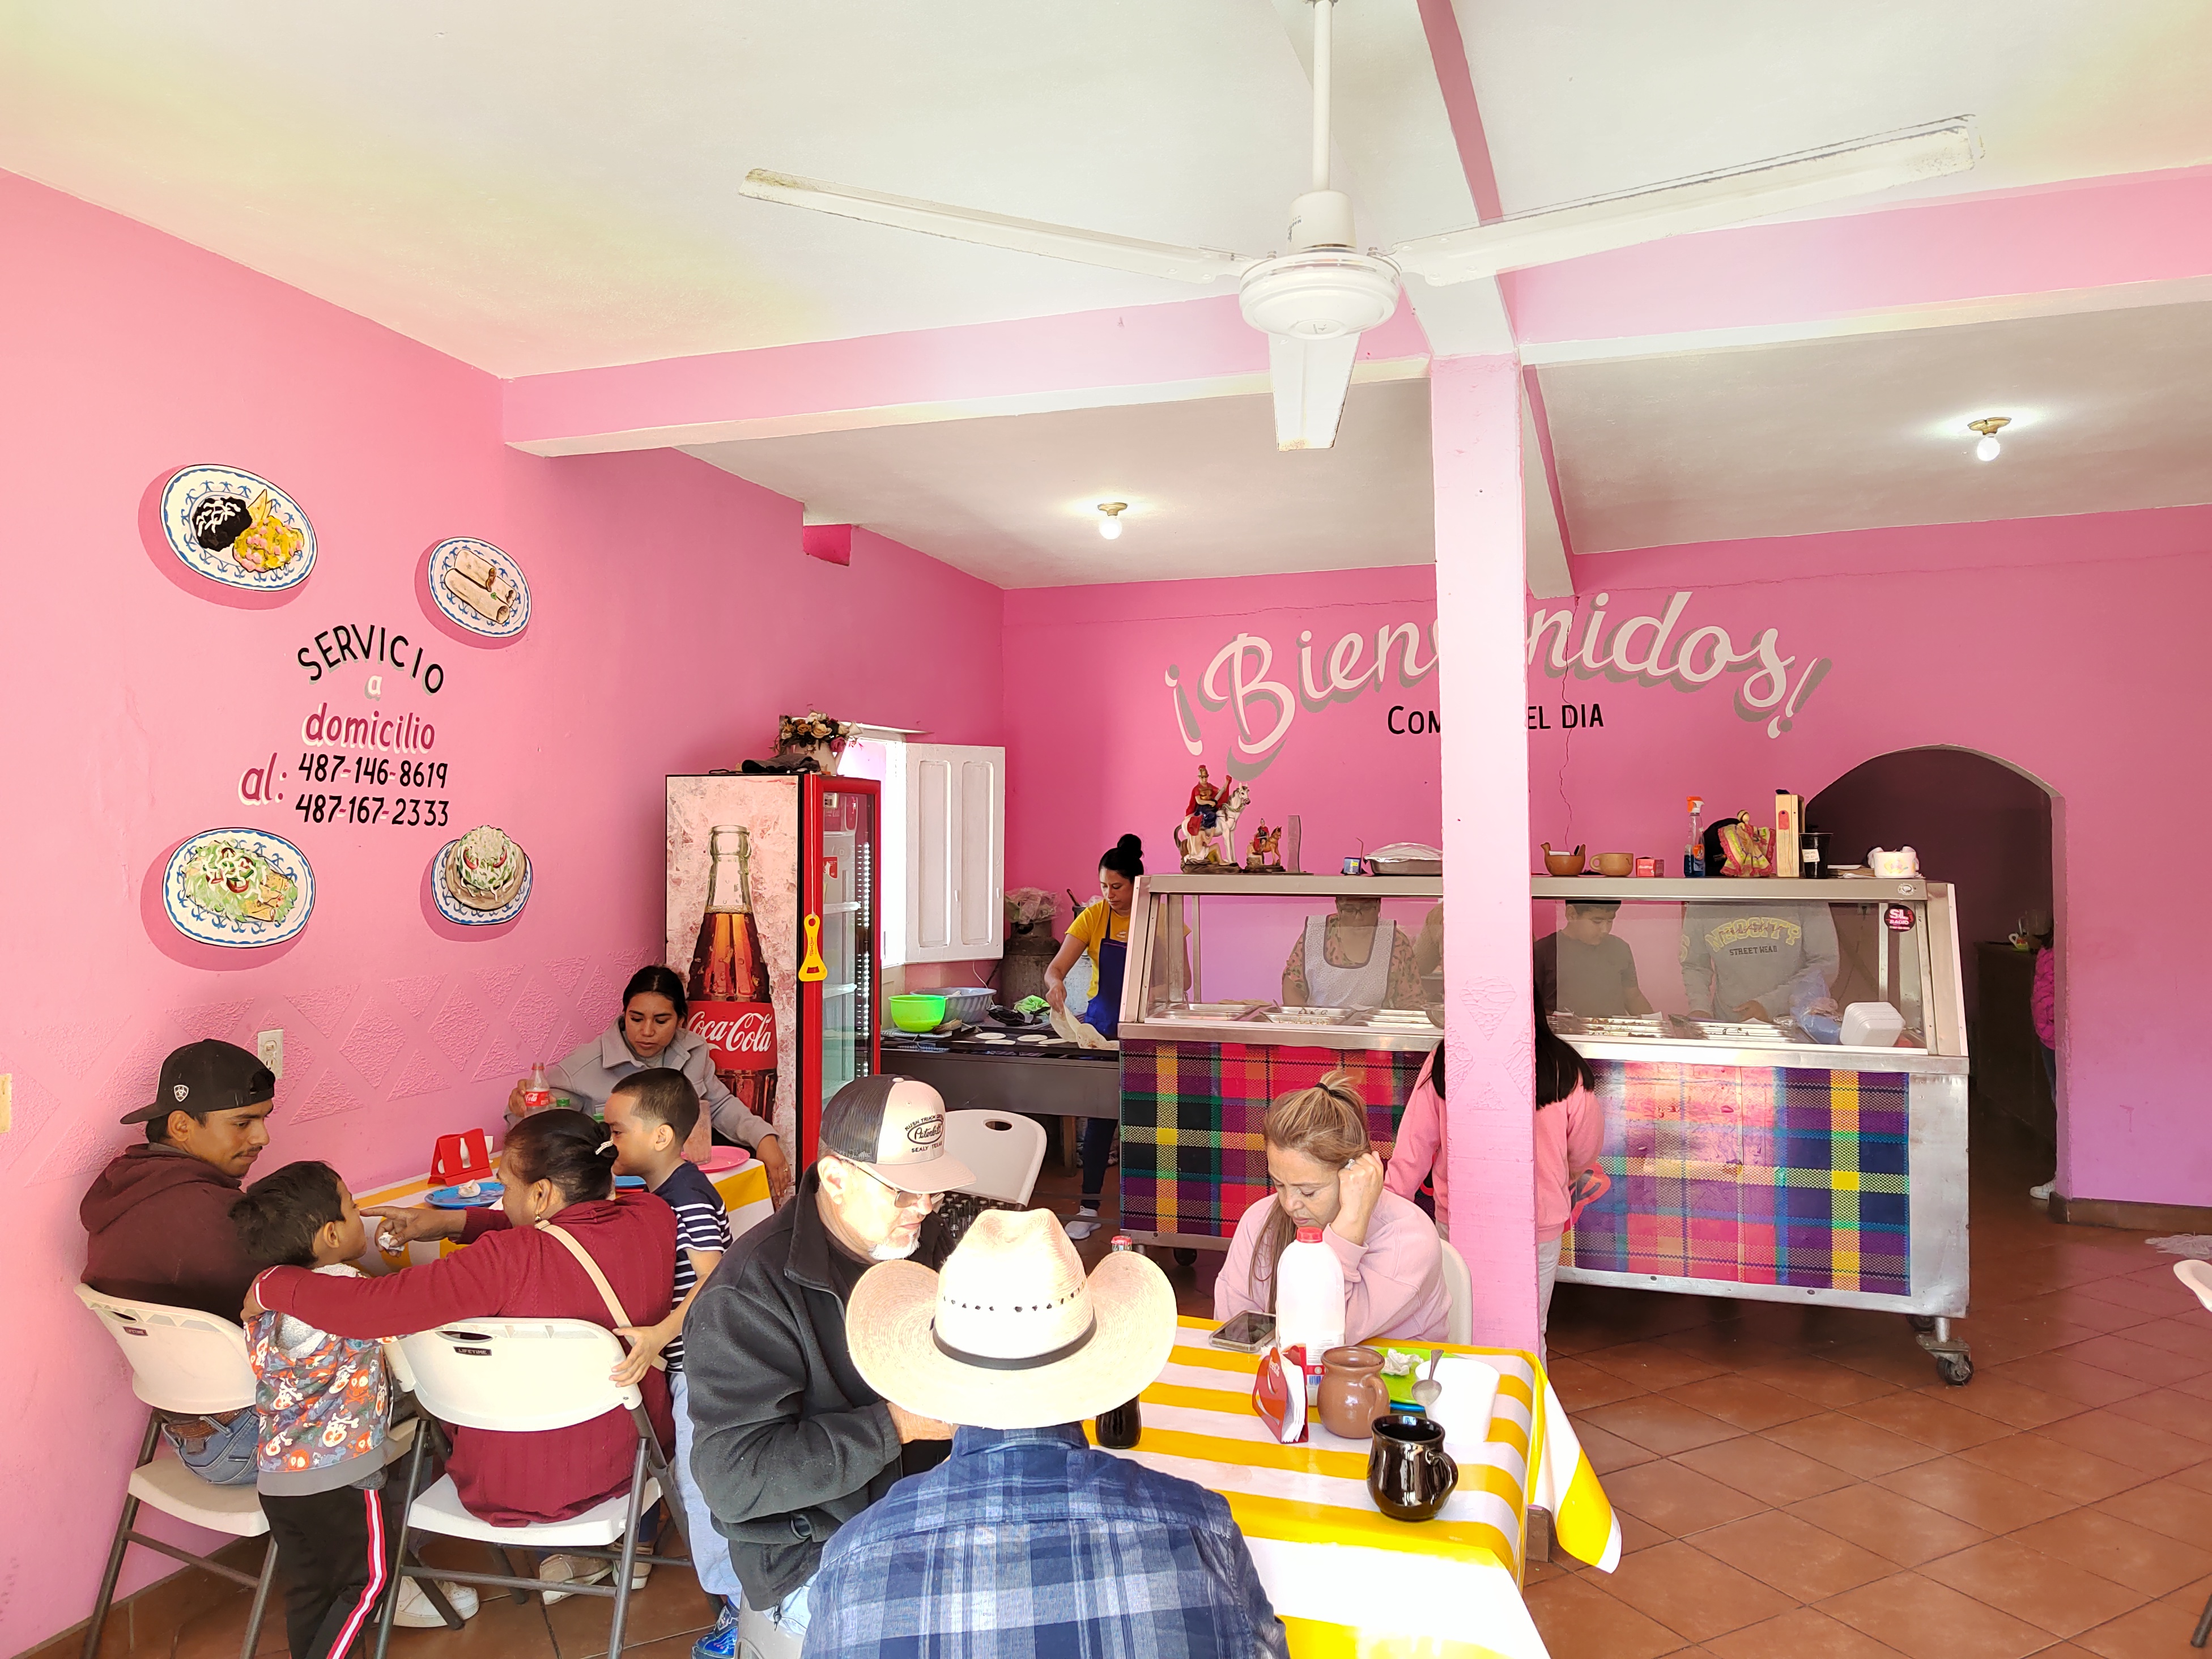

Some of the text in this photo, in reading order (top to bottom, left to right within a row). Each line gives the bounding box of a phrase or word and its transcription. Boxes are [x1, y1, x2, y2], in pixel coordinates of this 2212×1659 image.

[297, 624, 444, 695] SERVICIO
[1165, 591, 1832, 762] ¡Biennidos!
[366, 675, 383, 699] a
[303, 703, 435, 752] domicilio
[1528, 705, 1551, 730] EL
[1562, 704, 1604, 729] DIA
[239, 752, 448, 803] al: 487-146-8619
[295, 794, 449, 826] 487-167-2333
[1729, 947, 1758, 956] STREET
[688, 1011, 773, 1052] Coca-Cola
